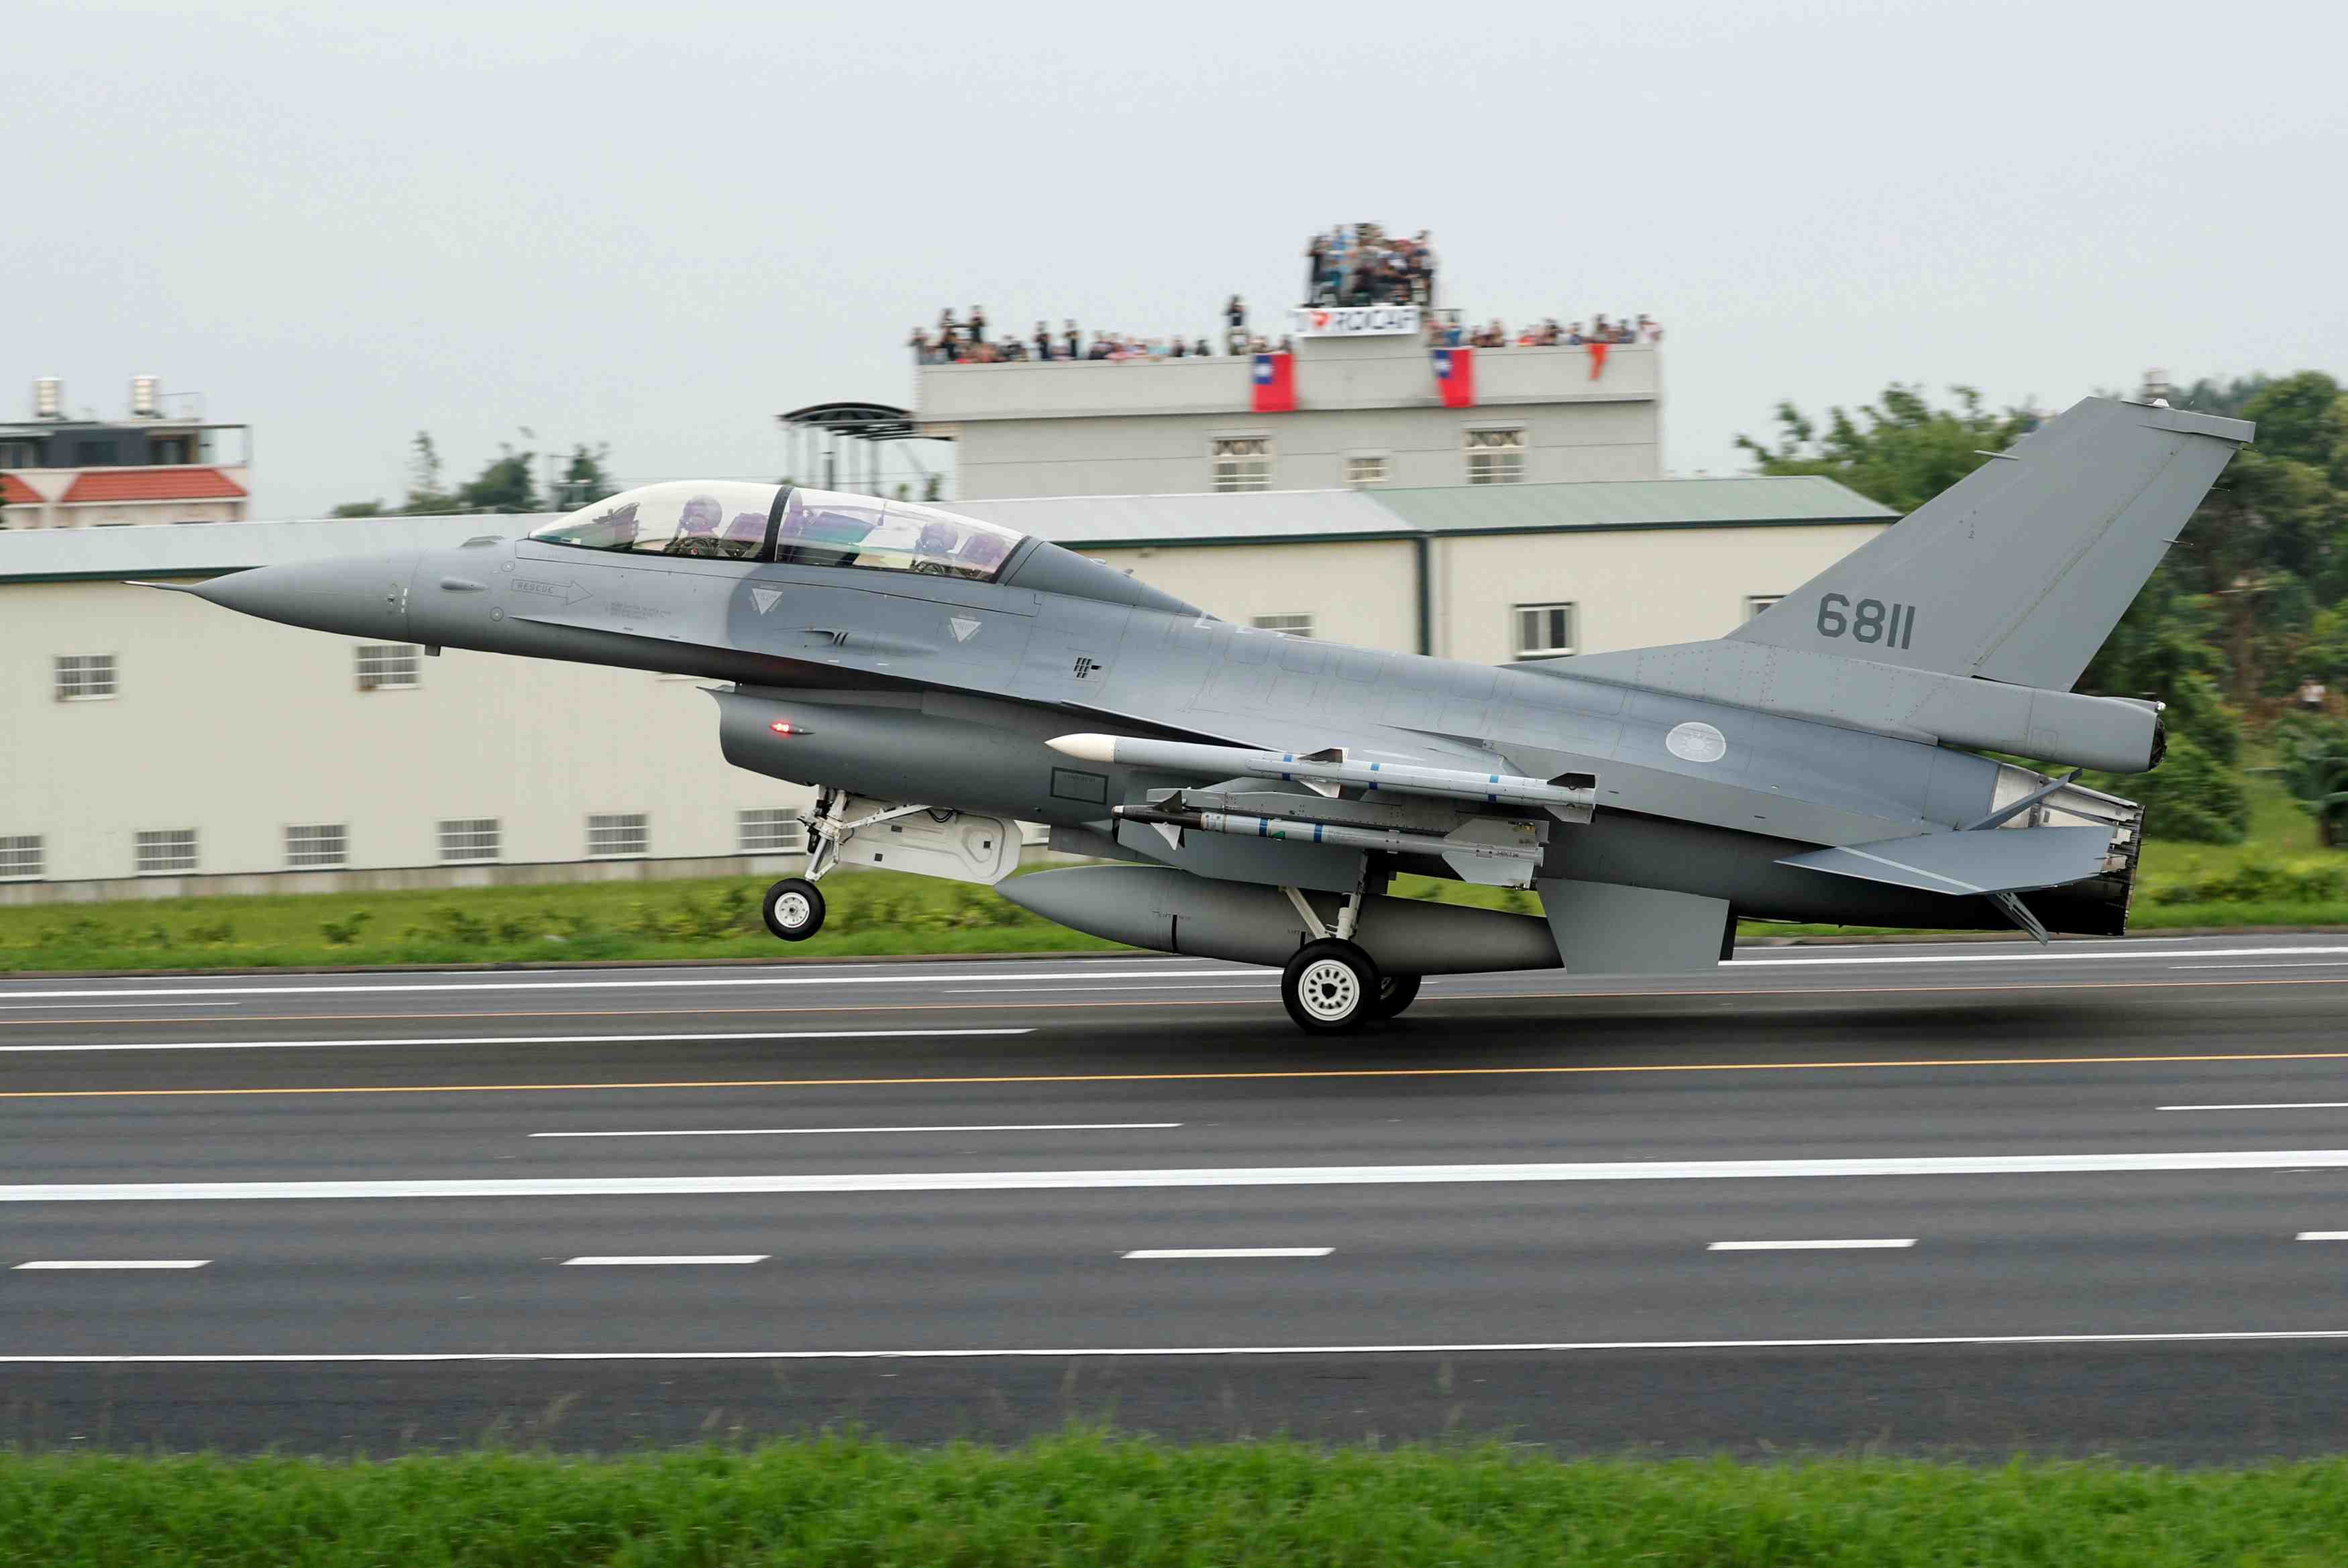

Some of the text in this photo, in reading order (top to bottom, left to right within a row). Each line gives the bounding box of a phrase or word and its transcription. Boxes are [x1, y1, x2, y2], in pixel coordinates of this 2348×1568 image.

[1332, 309, 1416, 332] ROCAF
[517, 581, 554, 594] RESCUE
[1817, 593, 1916, 650] 6811
